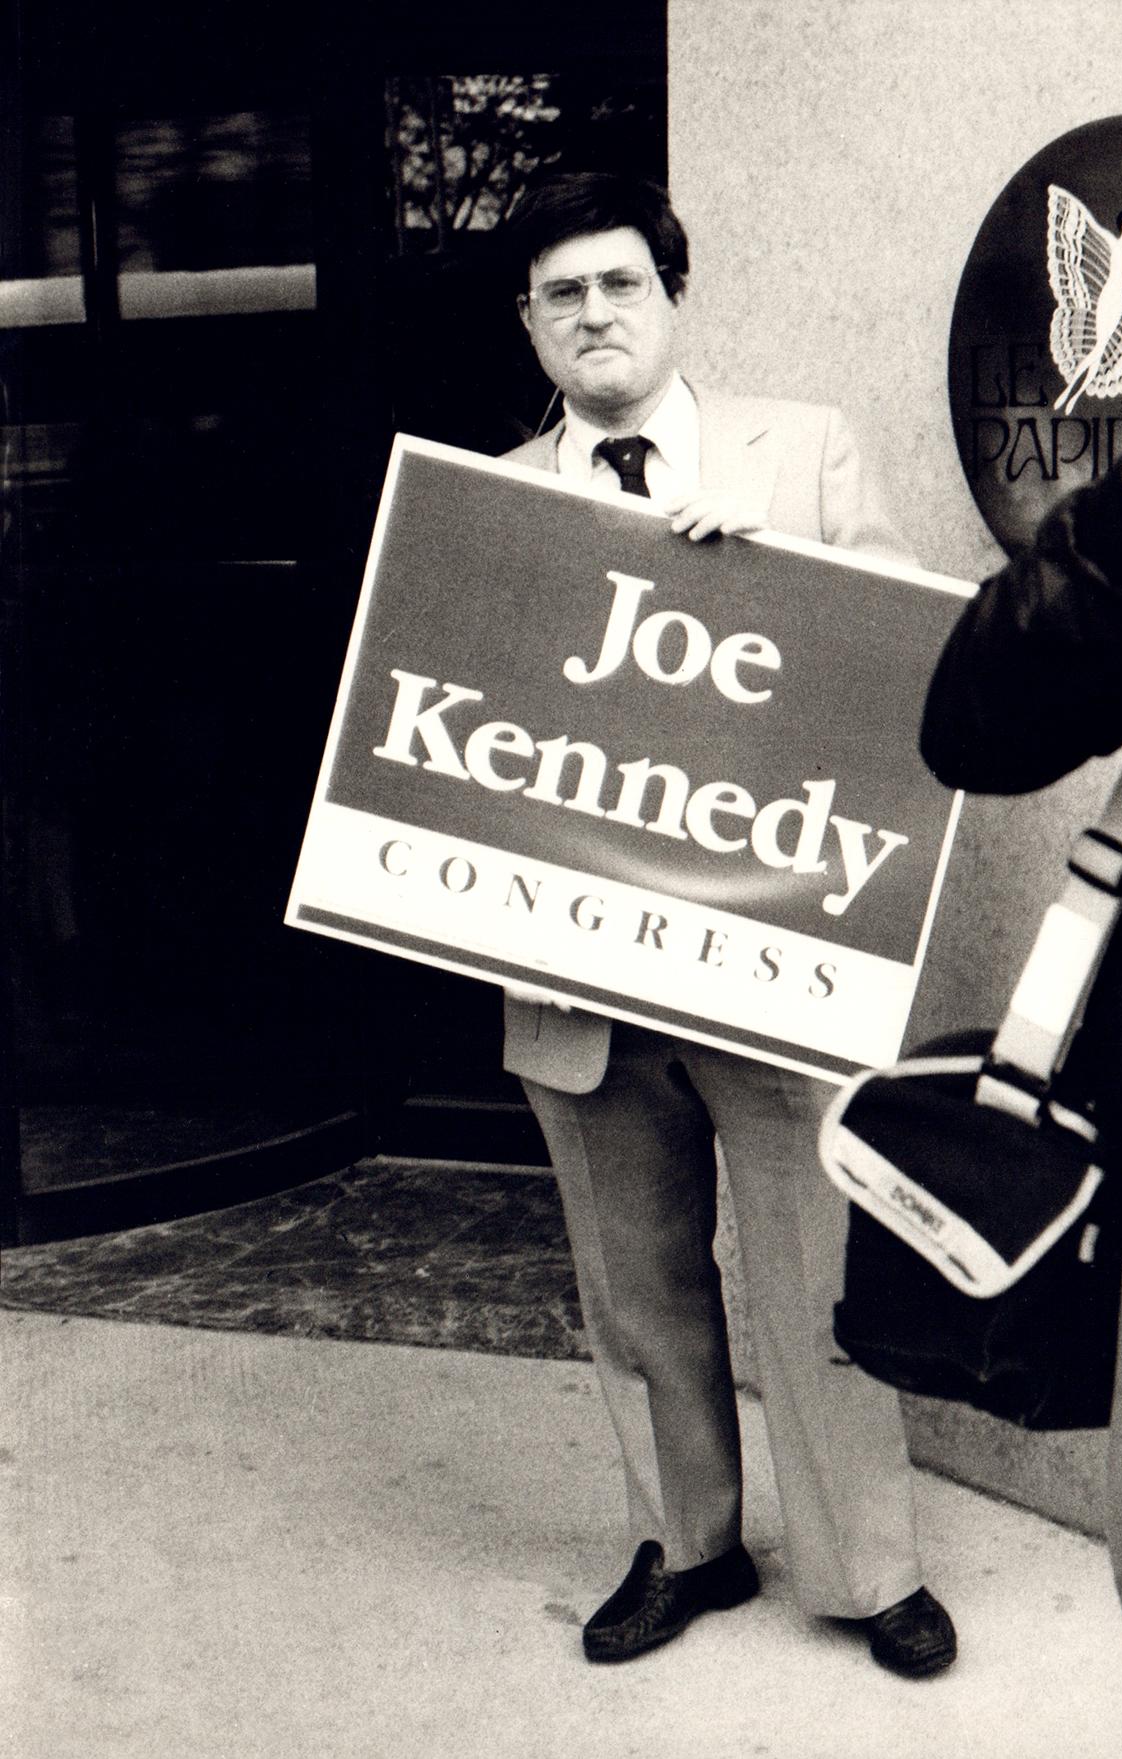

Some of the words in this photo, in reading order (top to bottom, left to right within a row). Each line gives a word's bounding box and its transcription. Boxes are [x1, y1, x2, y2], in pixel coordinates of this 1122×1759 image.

[969, 344, 1048, 407] LE
[563, 570, 782, 704] Joe
[372, 668, 909, 915] Kennedy
[378, 840, 838, 999] CONGRESS
